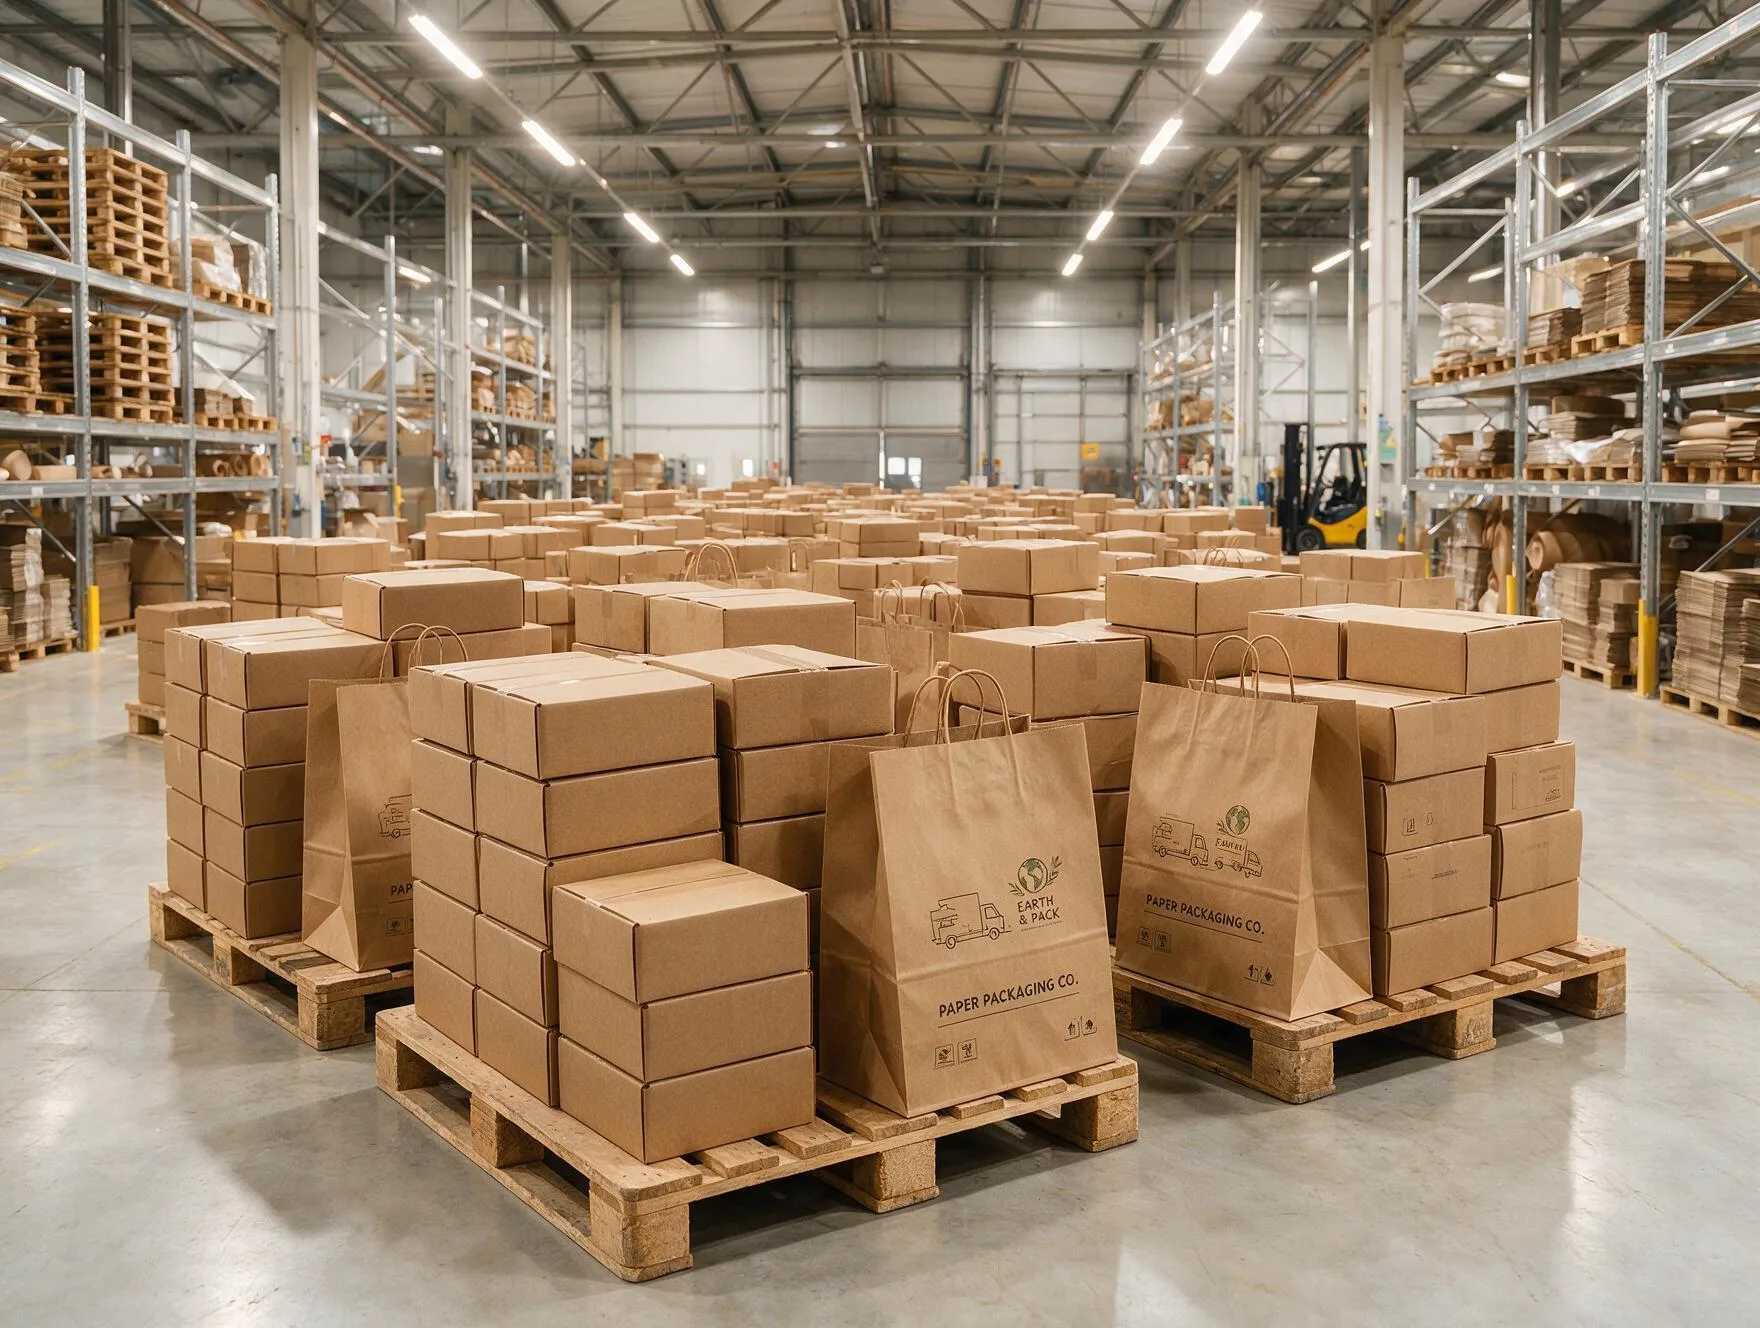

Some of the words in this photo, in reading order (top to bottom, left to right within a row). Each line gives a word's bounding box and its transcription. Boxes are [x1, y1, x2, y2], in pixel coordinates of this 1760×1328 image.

[391, 882, 414, 896] PAP
[1017, 895, 1054, 913] EARTH
[1019, 914, 1028, 925] &
[1031, 907, 1060, 923] PACK
[1146, 894, 1177, 913] PAPER
[1181, 903, 1242, 929] PACKAGING
[1245, 919, 1265, 935] CO.
[939, 997, 979, 1018] PAPER
[984, 978, 1055, 1007] PACKAGING
[1058, 973, 1079, 988] CO.
